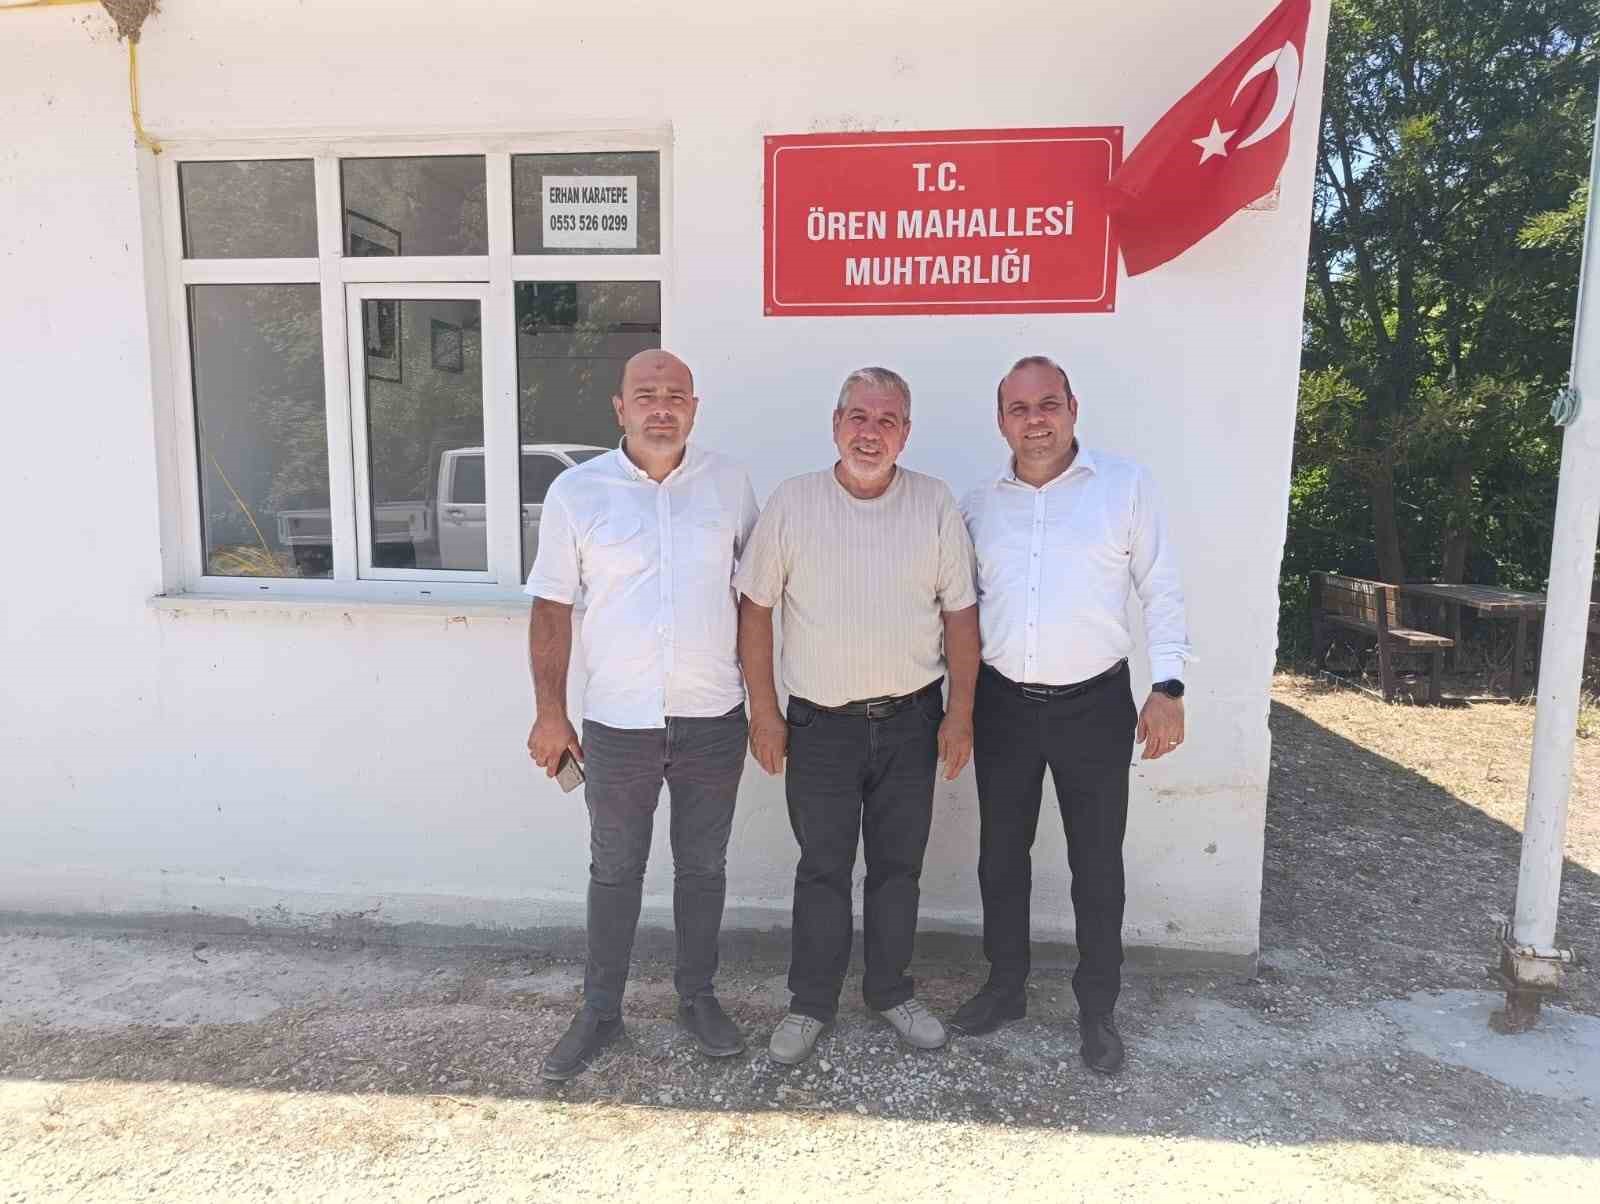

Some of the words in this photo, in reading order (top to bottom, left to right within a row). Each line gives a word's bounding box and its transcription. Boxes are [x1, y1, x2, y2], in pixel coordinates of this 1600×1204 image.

[912, 161, 966, 192] T.C.
[549, 186, 580, 204] ERHAN
[582, 186, 628, 204] KARATEPE
[550, 214, 577, 231] 0553
[578, 214, 599, 231] 526
[601, 214, 628, 231] 0299
[807, 206, 887, 241] ÖREN
[896, 200, 1075, 240] MAHALLESİ
[845, 248, 1031, 287] MUHTARLIĞI
